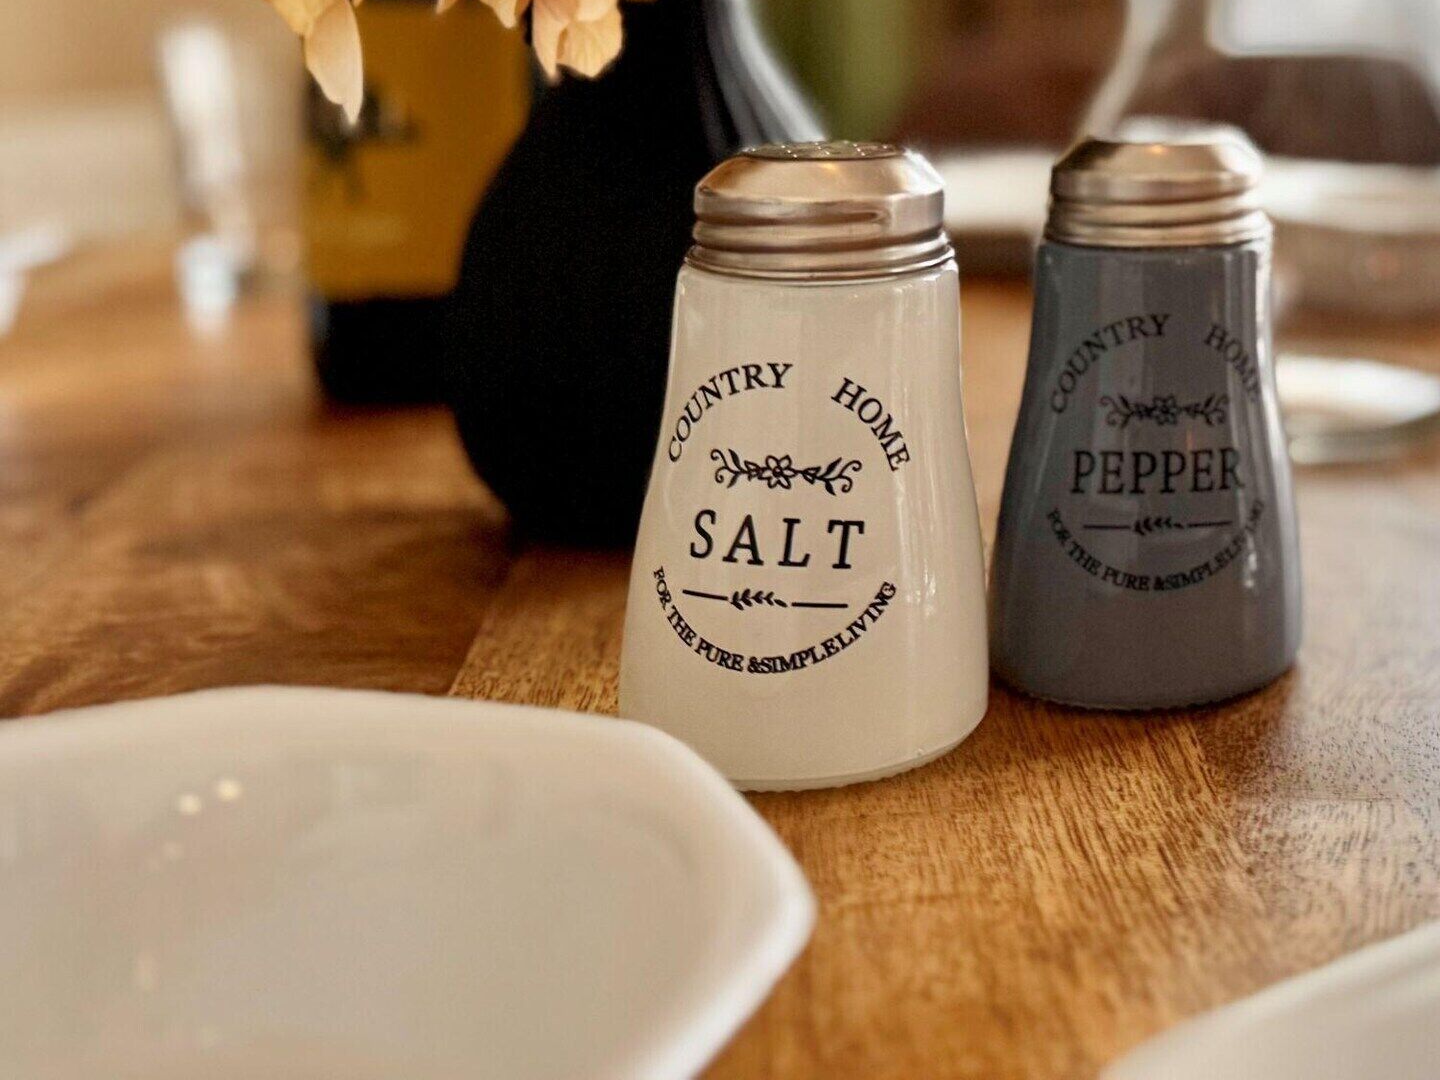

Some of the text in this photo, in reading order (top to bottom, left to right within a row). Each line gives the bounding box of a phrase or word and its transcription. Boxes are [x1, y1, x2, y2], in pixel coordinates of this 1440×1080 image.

[1050, 313, 1171, 414] COUNTRY
[667, 362, 913, 473] COUNTRY HOME
[1069, 446, 1246, 496] PEPPER
[689, 508, 866, 570] SALT
[1046, 507, 1071, 544] FOR
[1067, 541, 1103, 576] THE
[1101, 565, 1150, 591] PURE
[653, 566, 673, 610] FOR
[666, 605, 698, 648] THE
[694, 637, 745, 672] PURE
